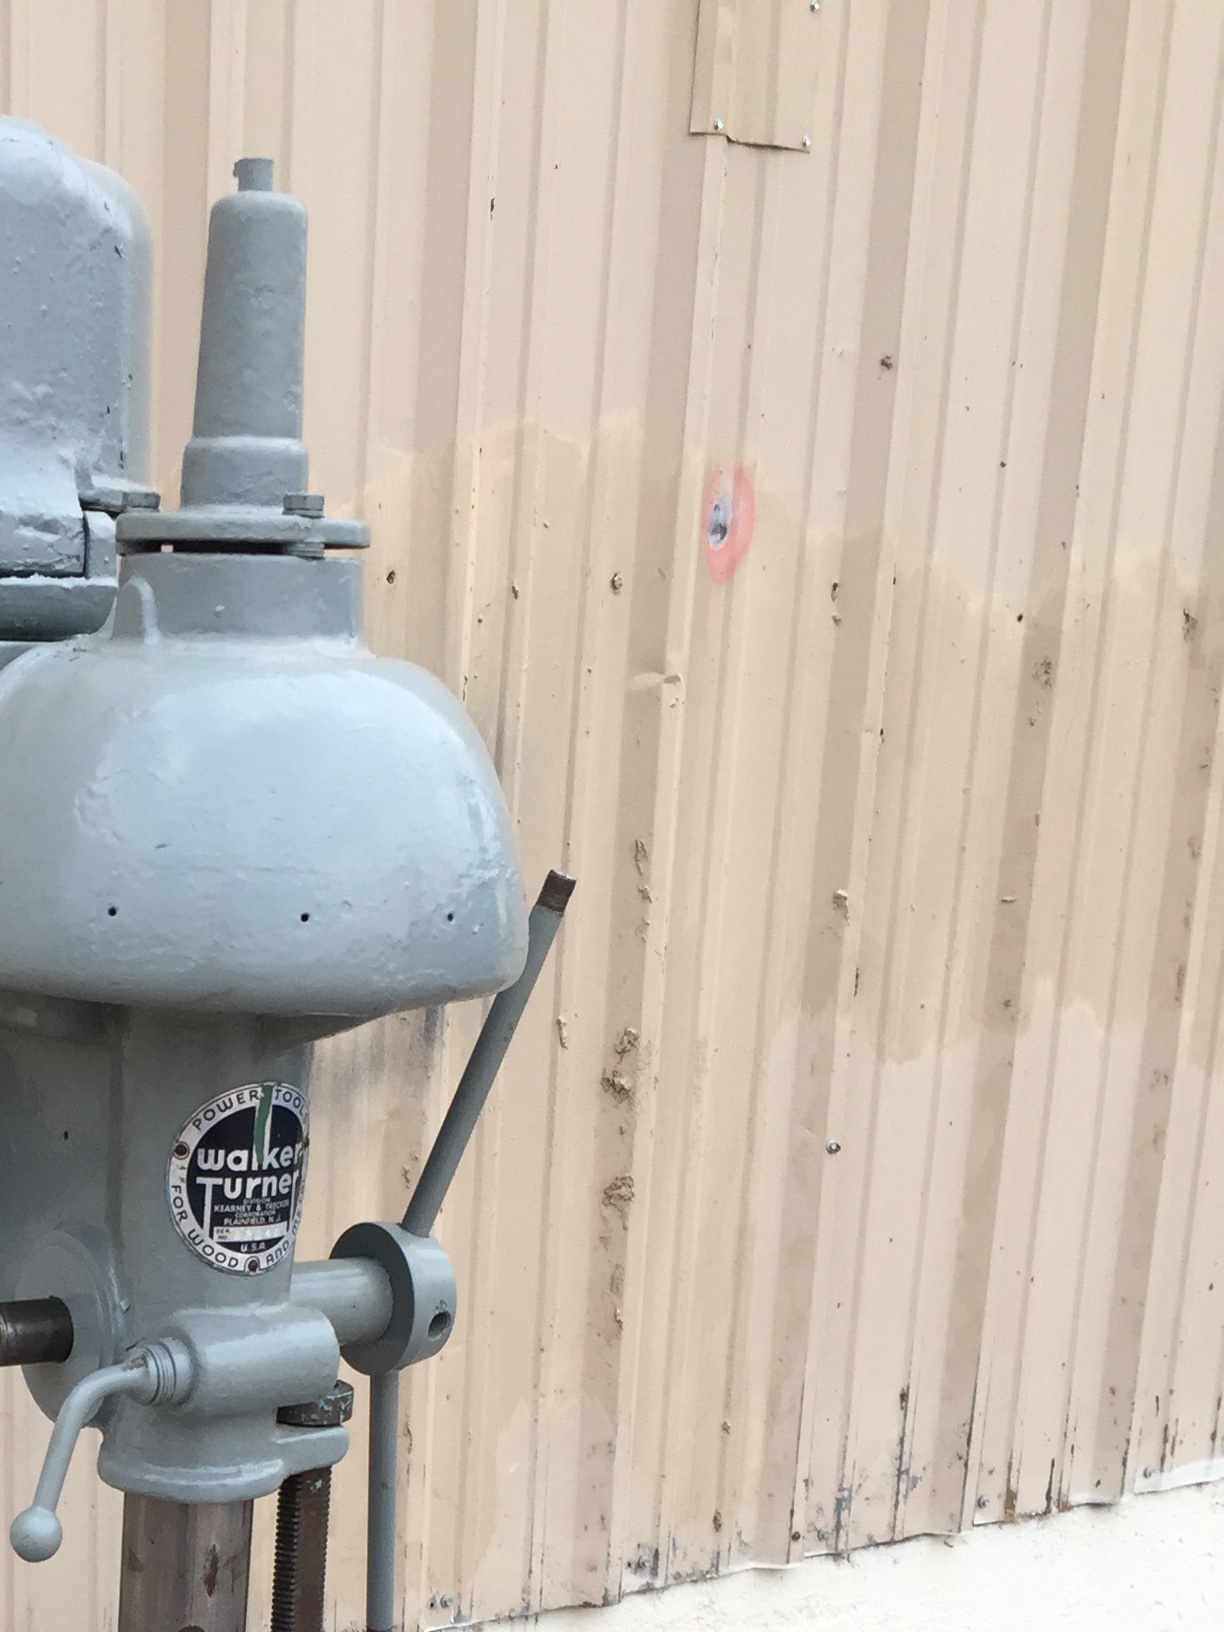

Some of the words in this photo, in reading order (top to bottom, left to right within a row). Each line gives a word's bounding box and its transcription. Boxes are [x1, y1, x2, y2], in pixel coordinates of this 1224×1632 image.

[192, 1089, 261, 1131] POWER
[171, 1184, 188, 1223] FOR
[187, 1228, 240, 1269] WOOD
[265, 1239, 291, 1266] AND
[213, 1204, 252, 1213] KEARNEY
